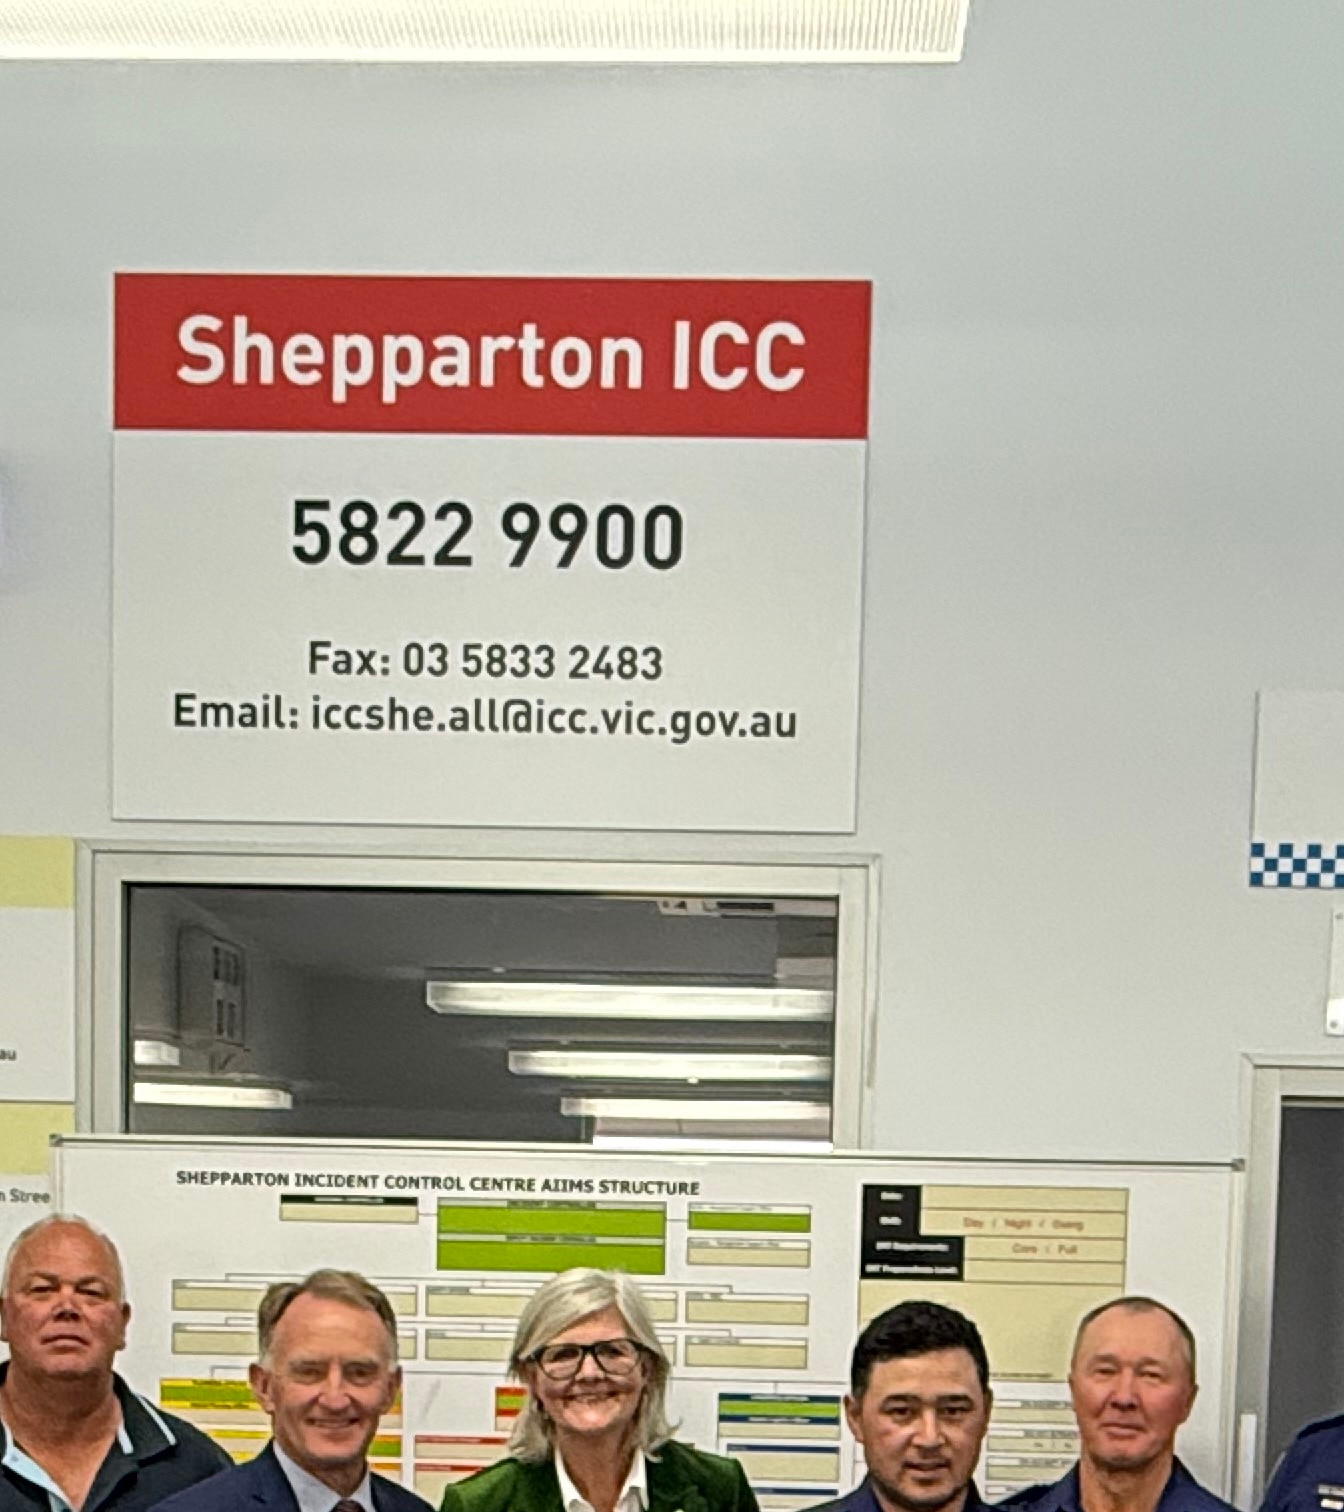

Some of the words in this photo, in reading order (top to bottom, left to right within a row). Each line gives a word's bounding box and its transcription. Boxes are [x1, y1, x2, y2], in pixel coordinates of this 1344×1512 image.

[177, 315, 642, 403] Shepparton
[674, 321, 805, 391] ICC
[293, 500, 473, 566] 5822
[501, 502, 683, 570] 9900
[309, 641, 389, 675] Fax:
[403, 642, 449, 677] 03
[462, 643, 555, 678] 5833
[569, 645, 662, 680] 2483
[175, 693, 298, 729] Email:
[313, 695, 796, 745] iccshe.all@icc.vic.gov.au
[9, 1188, 51, 1203] Stree
[177, 1171, 289, 1187] SHEPPARTON
[295, 1173, 379, 1188] INCIDENT
[384, 1175, 465, 1191] CONTROL
[469, 1177, 536, 1192] CENTRE
[541, 1178, 595, 1193] AIIMS
[599, 1180, 700, 1195] STRUCTURE
